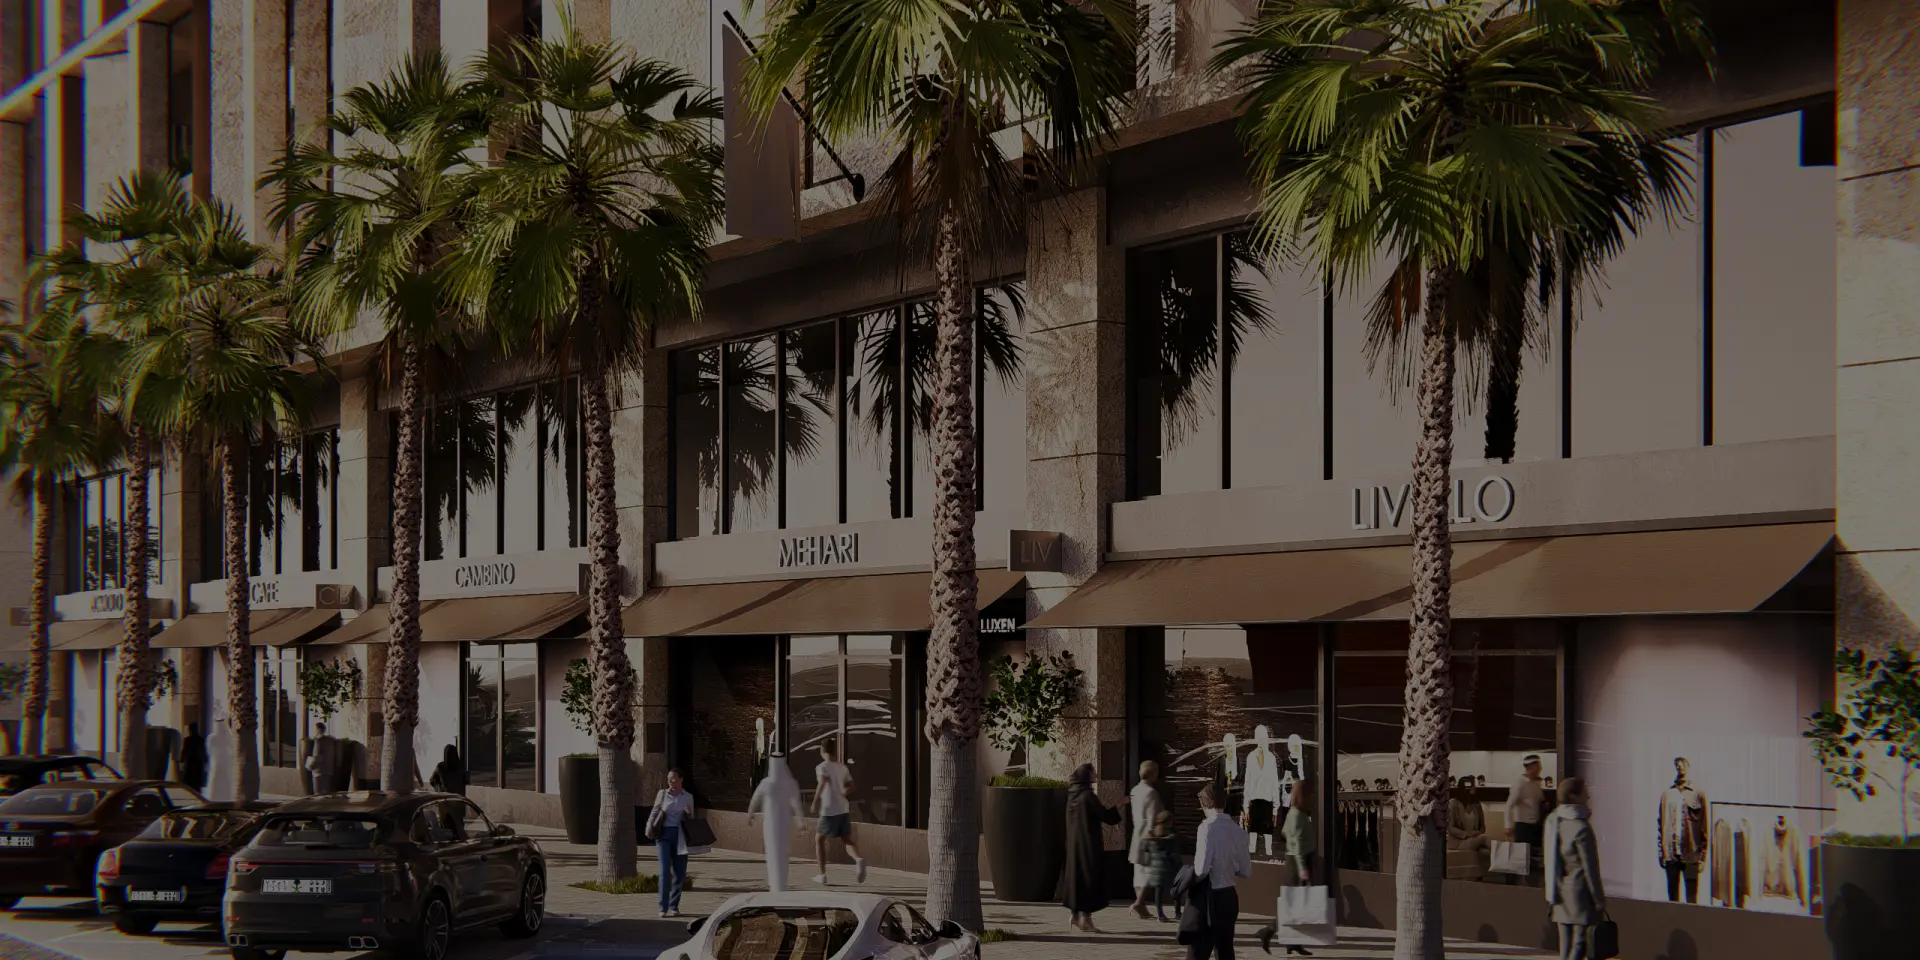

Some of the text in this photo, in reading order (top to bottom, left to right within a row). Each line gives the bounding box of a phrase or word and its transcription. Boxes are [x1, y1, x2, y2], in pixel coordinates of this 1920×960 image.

[1351, 475, 1515, 530] LIVLO
[779, 532, 859, 568] MEHARI
[1020, 540, 1053, 563] LIV
[455, 562, 516, 589] CAMBINO
[319, 586, 350, 605] CB
[980, 618, 1016, 633] LUXEN
